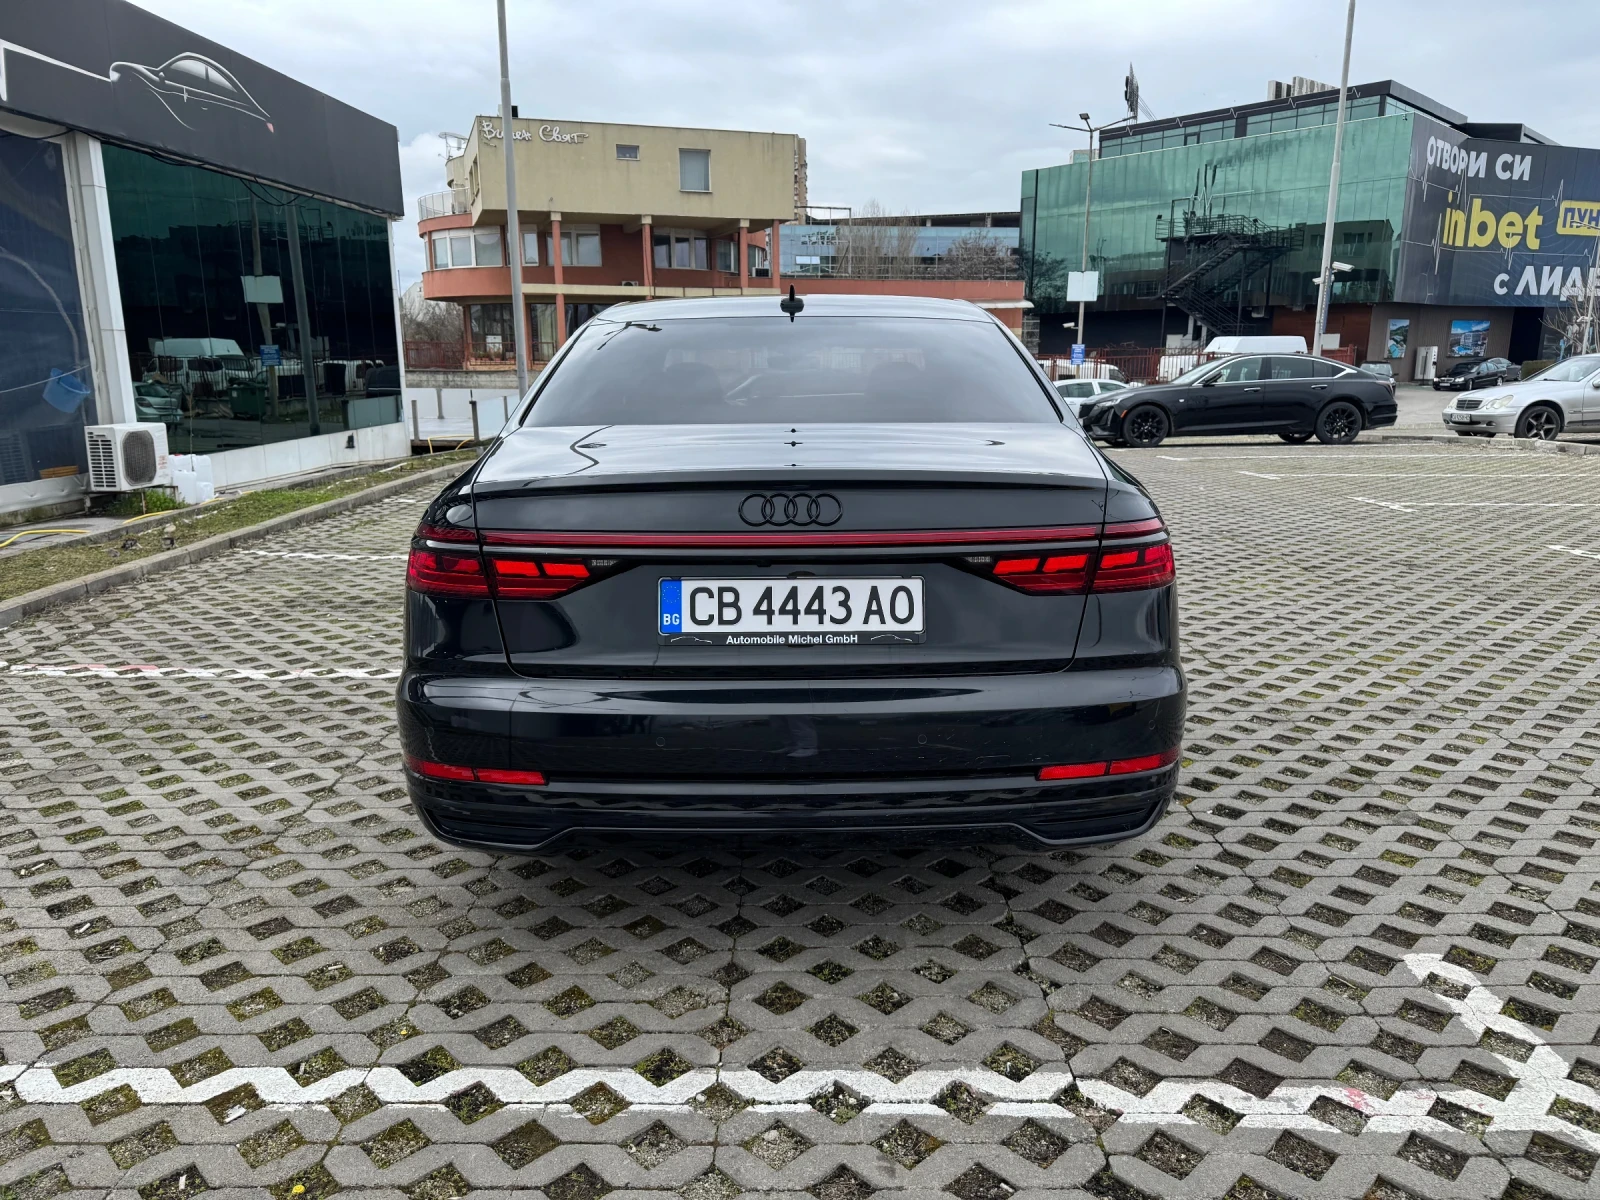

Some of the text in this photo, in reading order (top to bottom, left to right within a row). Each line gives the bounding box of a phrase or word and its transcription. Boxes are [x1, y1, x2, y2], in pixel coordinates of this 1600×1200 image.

[482, 120, 589, 144] Виен Свят
[1427, 136, 1532, 181] ОТВОРИ СИ
[1442, 190, 1543, 250] inbet
[663, 613, 680, 625] BG
[689, 585, 915, 626] CB 4443 AO
[726, 634, 858, 644] Automobile Michel GmbH
